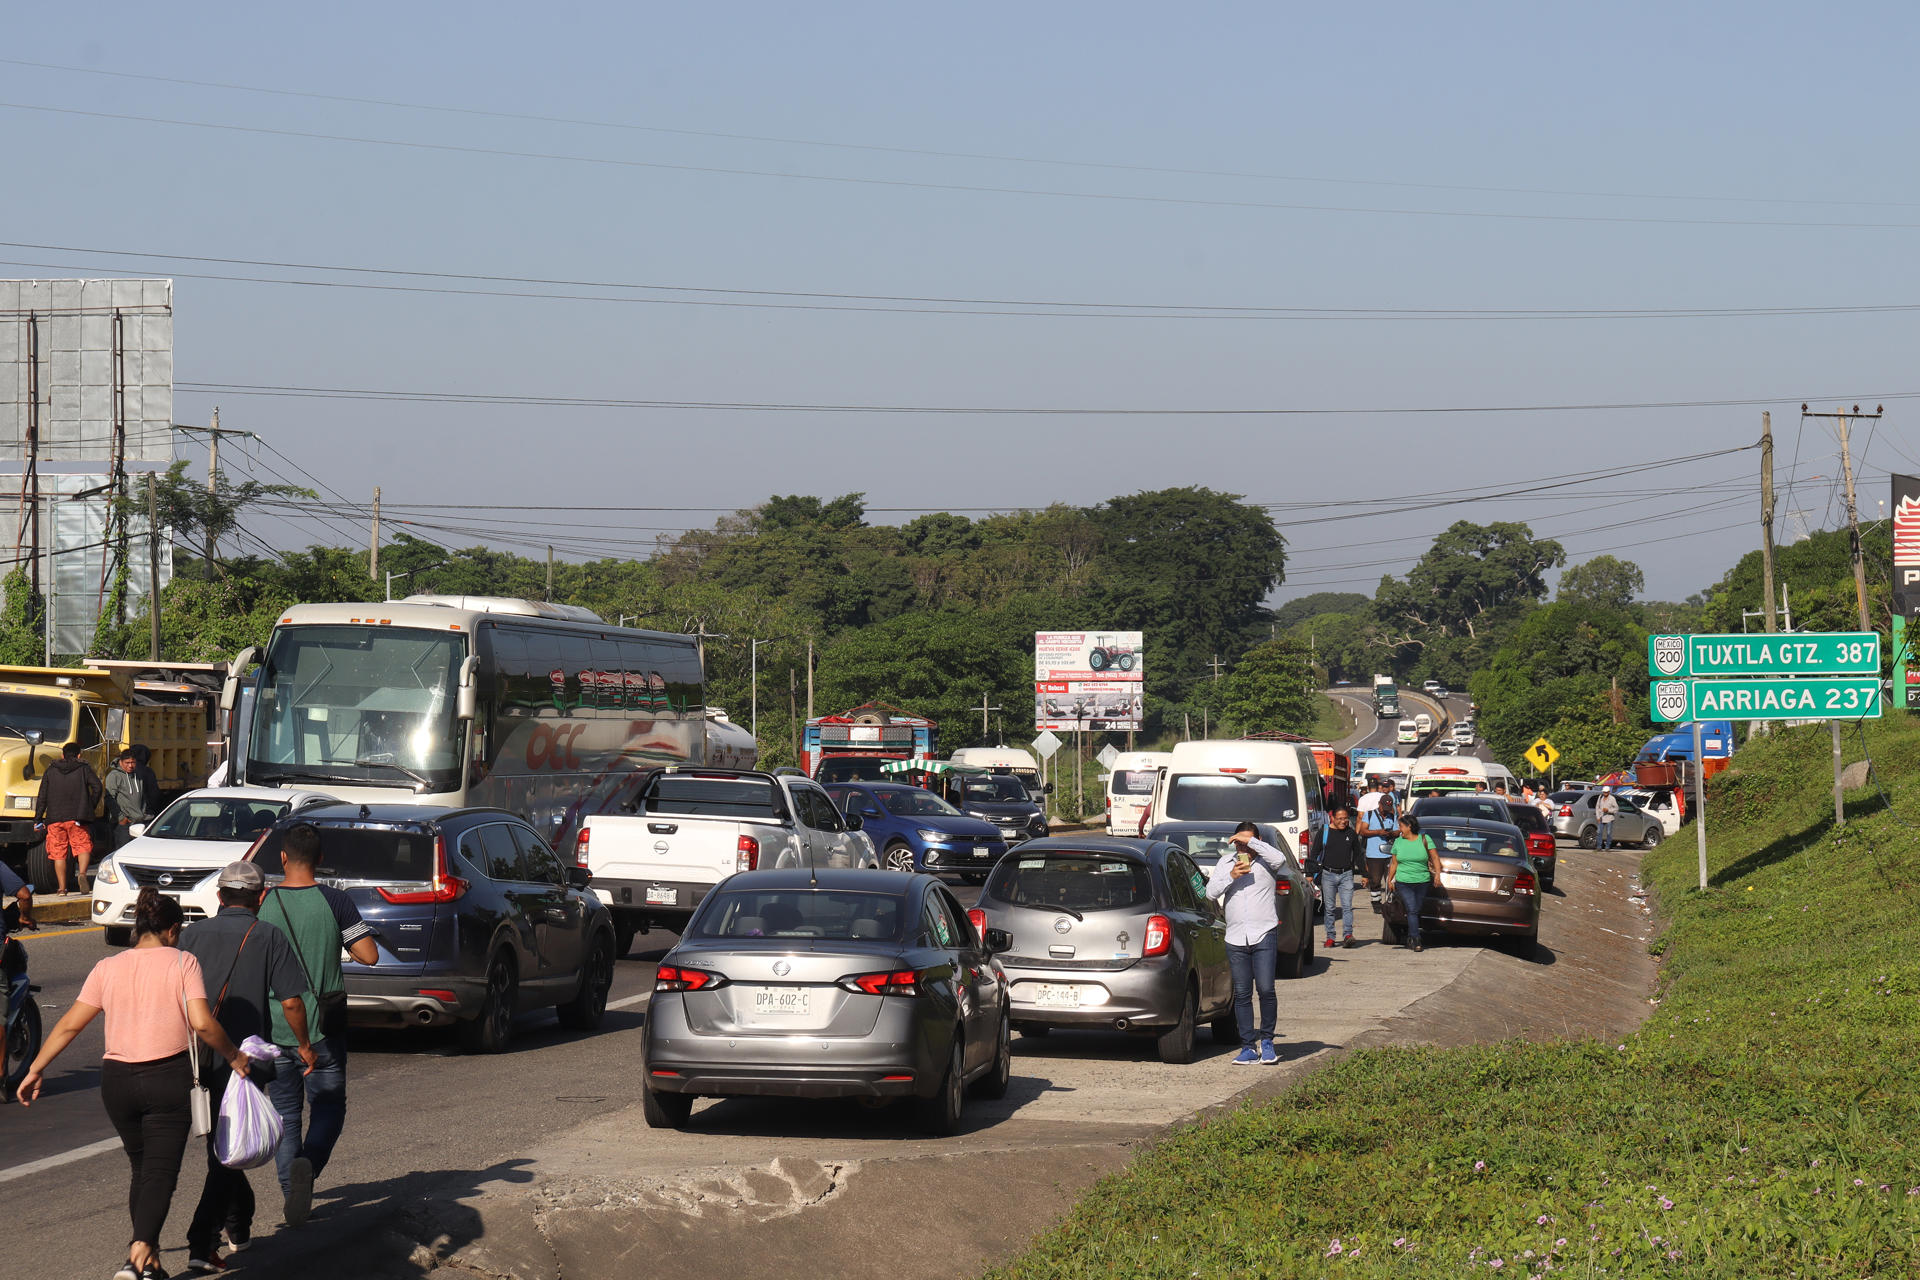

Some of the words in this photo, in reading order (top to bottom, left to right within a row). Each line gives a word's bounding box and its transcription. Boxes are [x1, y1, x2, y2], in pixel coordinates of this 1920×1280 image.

[1657, 640, 1681, 649] MEXICO
[1659, 651, 1681, 663] 200
[1696, 644, 1774, 665] TUXTLA
[1779, 643, 1823, 665] GTZ.
[1836, 642, 1876, 664] 387
[1660, 686, 1683, 695] MEXICO
[1661, 697, 1683, 709] 200
[1700, 689, 1816, 711] ARRIAGA
[1825, 688, 1876, 709] 237
[1105, 721, 1116, 729] 24
[526, 723, 587, 770] OCC
[1288, 826, 1298, 834] 03
[756, 991, 809, 1007] DPA-602-C
